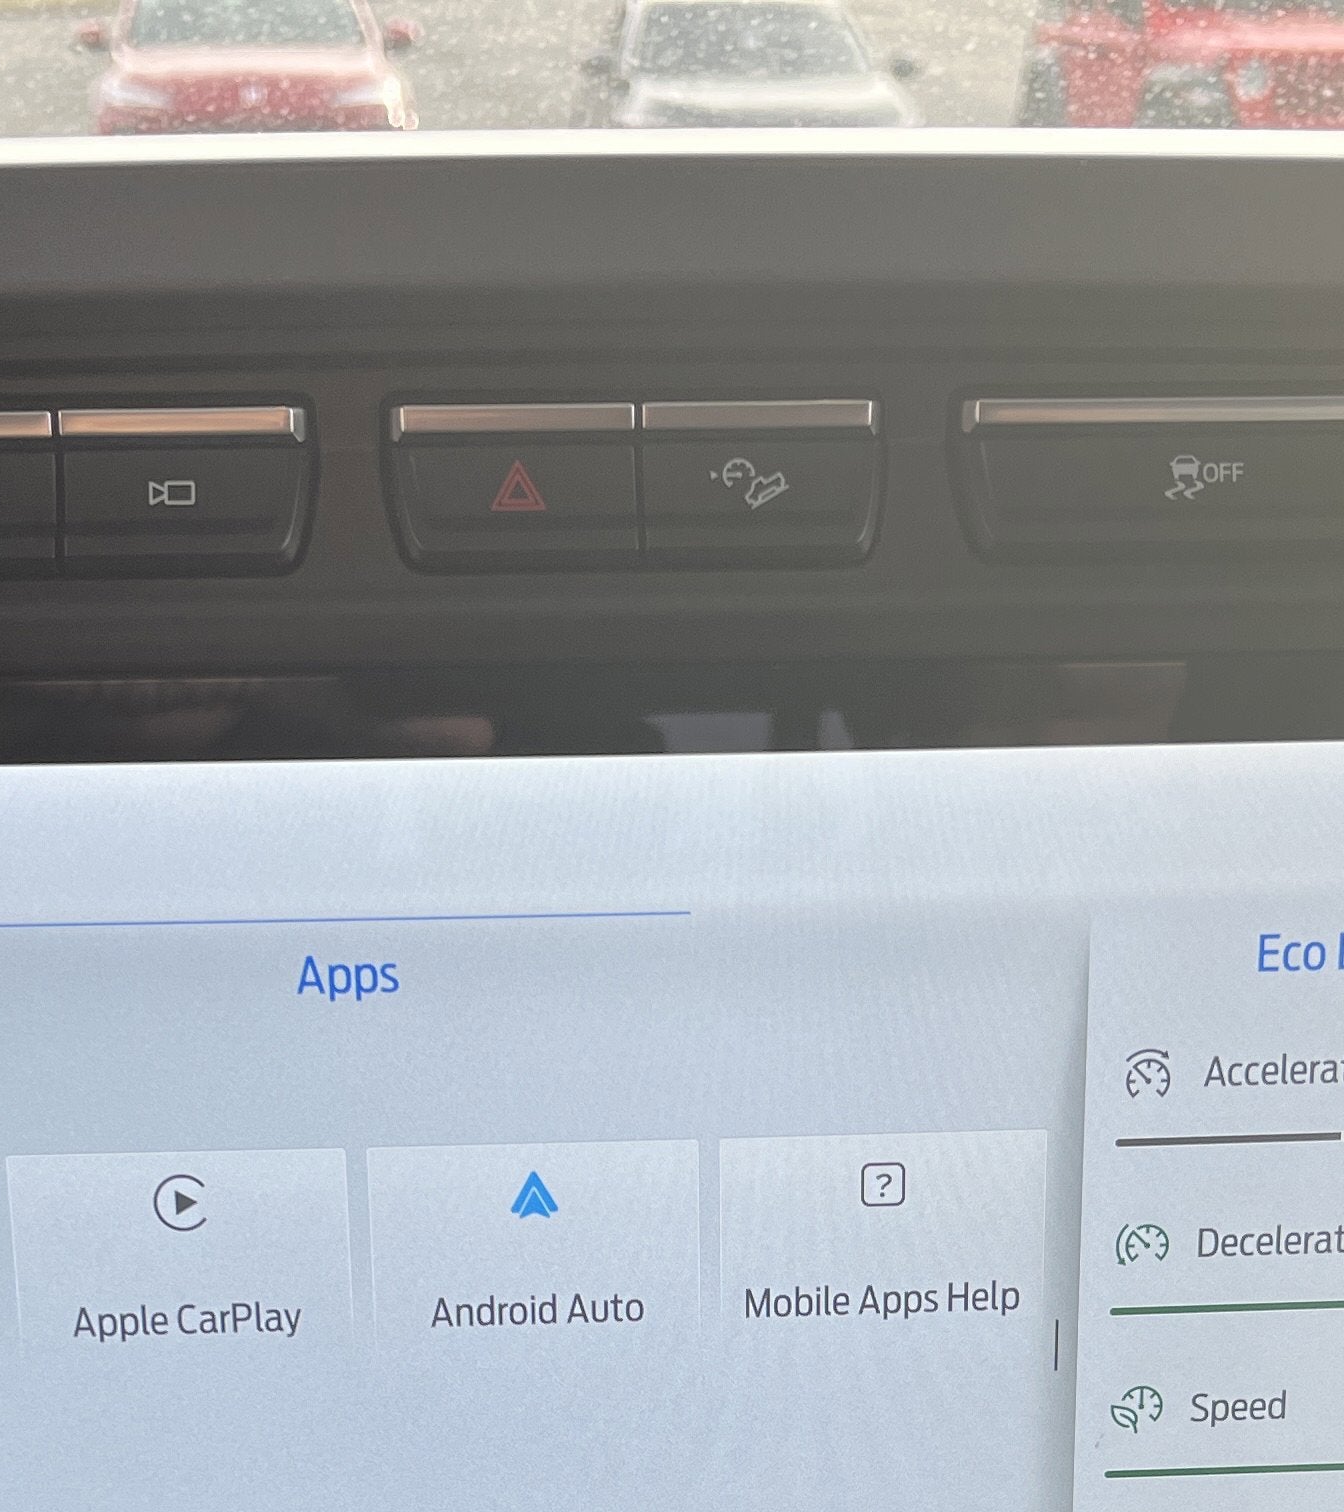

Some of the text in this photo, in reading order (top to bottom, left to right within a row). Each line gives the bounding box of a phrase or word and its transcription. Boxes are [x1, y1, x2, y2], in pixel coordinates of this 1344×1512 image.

[1202, 462, 1244, 483] OFF
[1258, 933, 1326, 972] Eco
[297, 955, 399, 1002] Apps
[431, 1293, 644, 1328] Android Auto
[745, 1279, 1020, 1320] Mobile Apps Help
[73, 1301, 302, 1343] Apple CarPlay
[1190, 1389, 1287, 1428] Speed
